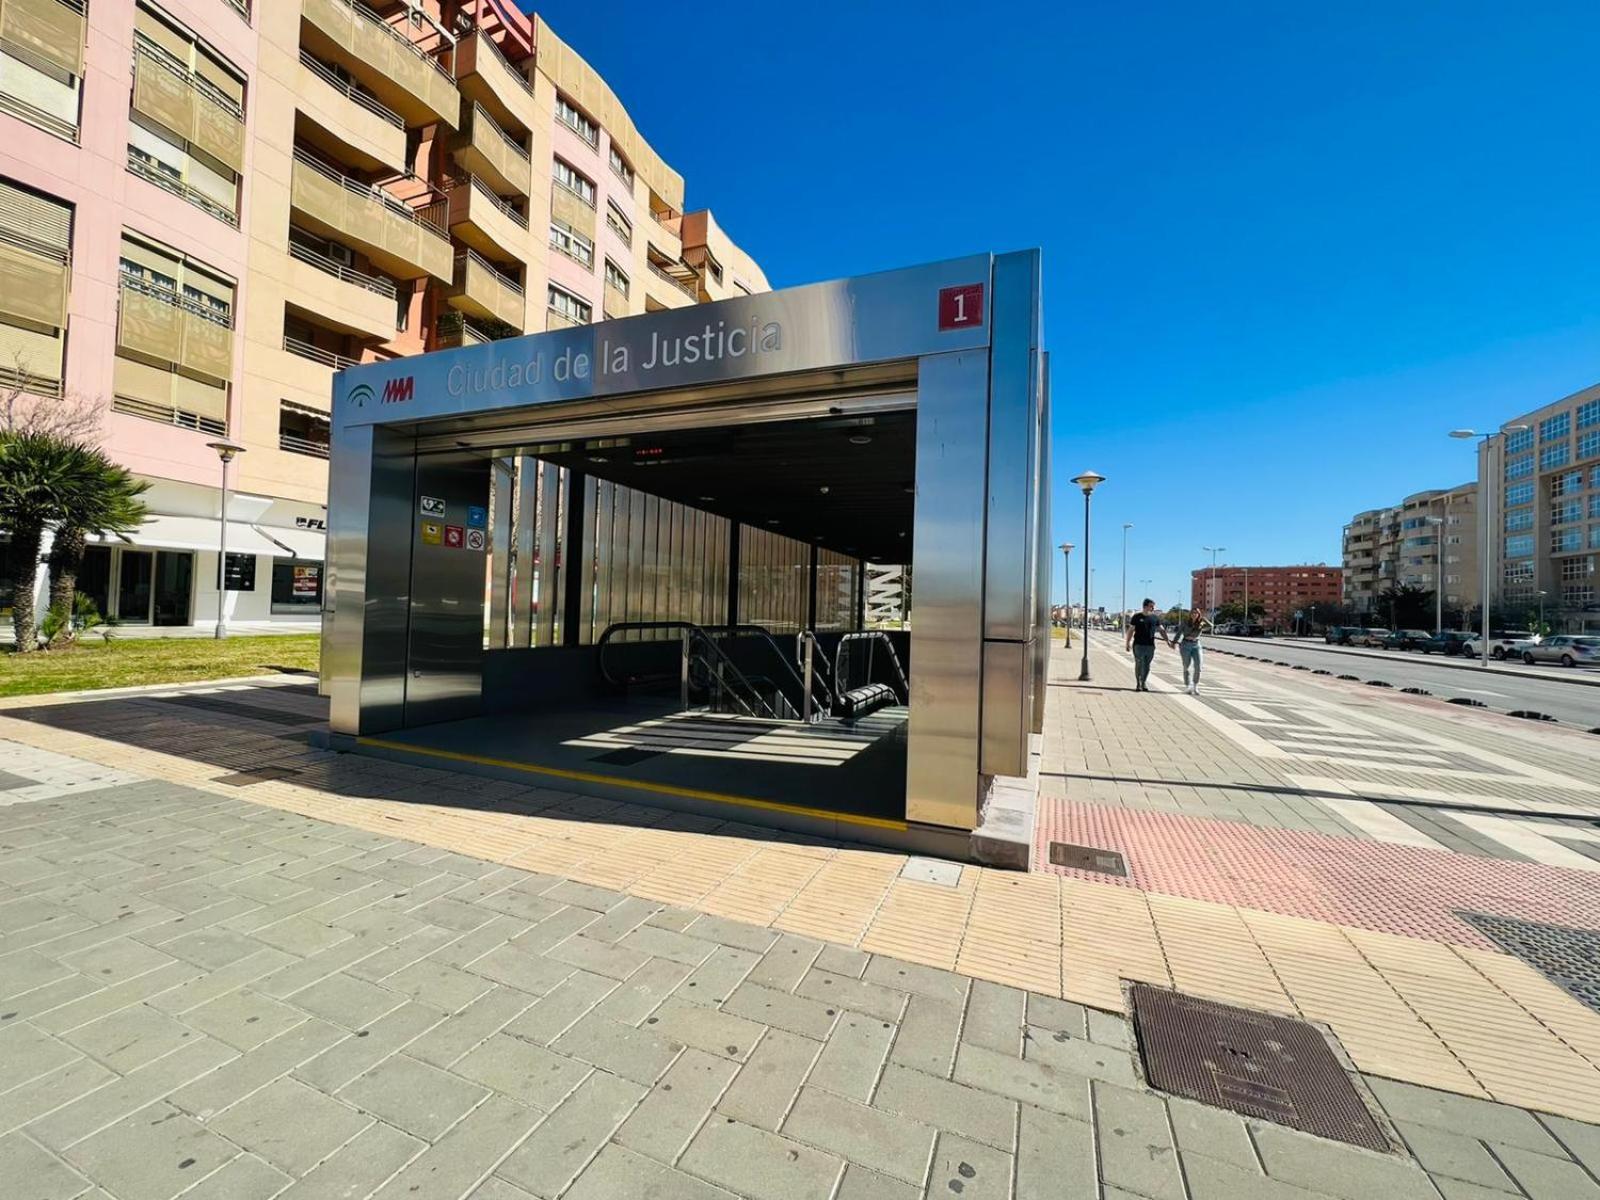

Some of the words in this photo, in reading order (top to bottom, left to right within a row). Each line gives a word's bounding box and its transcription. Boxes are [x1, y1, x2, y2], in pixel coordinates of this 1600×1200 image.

[953, 293, 968, 322] 1
[447, 350, 544, 397] Ciudad
[553, 346, 591, 383] de
[602, 339, 629, 375] la
[641, 315, 783, 370] Justicia
